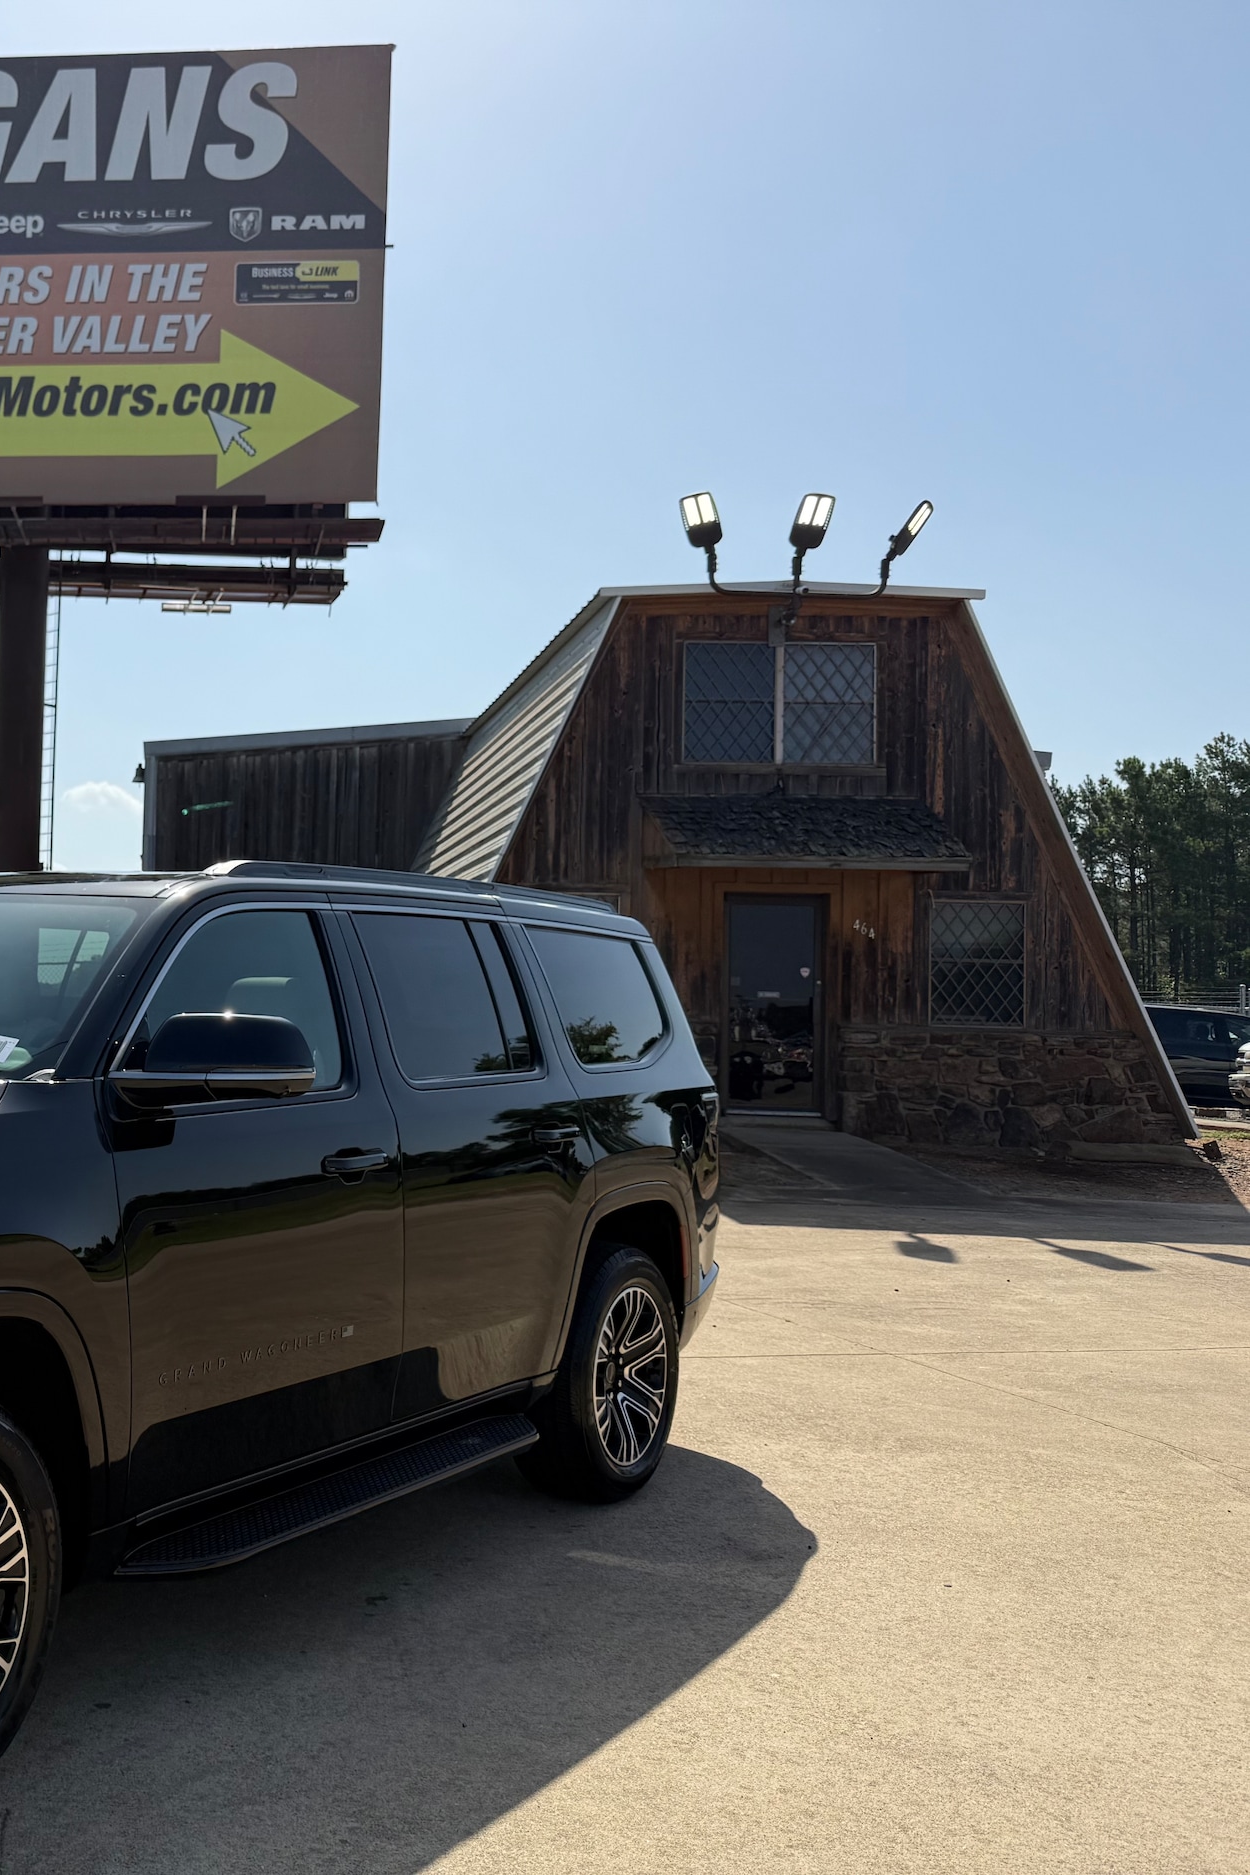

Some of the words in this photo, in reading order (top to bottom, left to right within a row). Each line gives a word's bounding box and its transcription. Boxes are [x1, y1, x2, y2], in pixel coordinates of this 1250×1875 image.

[77, 209, 193, 219] CHRYSLER
[270, 214, 366, 231] RAM
[252, 266, 294, 278] BUSINESS
[315, 266, 339, 277] LINK
[65, 264, 113, 304] IN
[127, 263, 208, 303] THE
[52, 313, 212, 355] VALLEY
[853, 919, 875, 939] 464
[158, 1356, 228, 1387] GRAND
